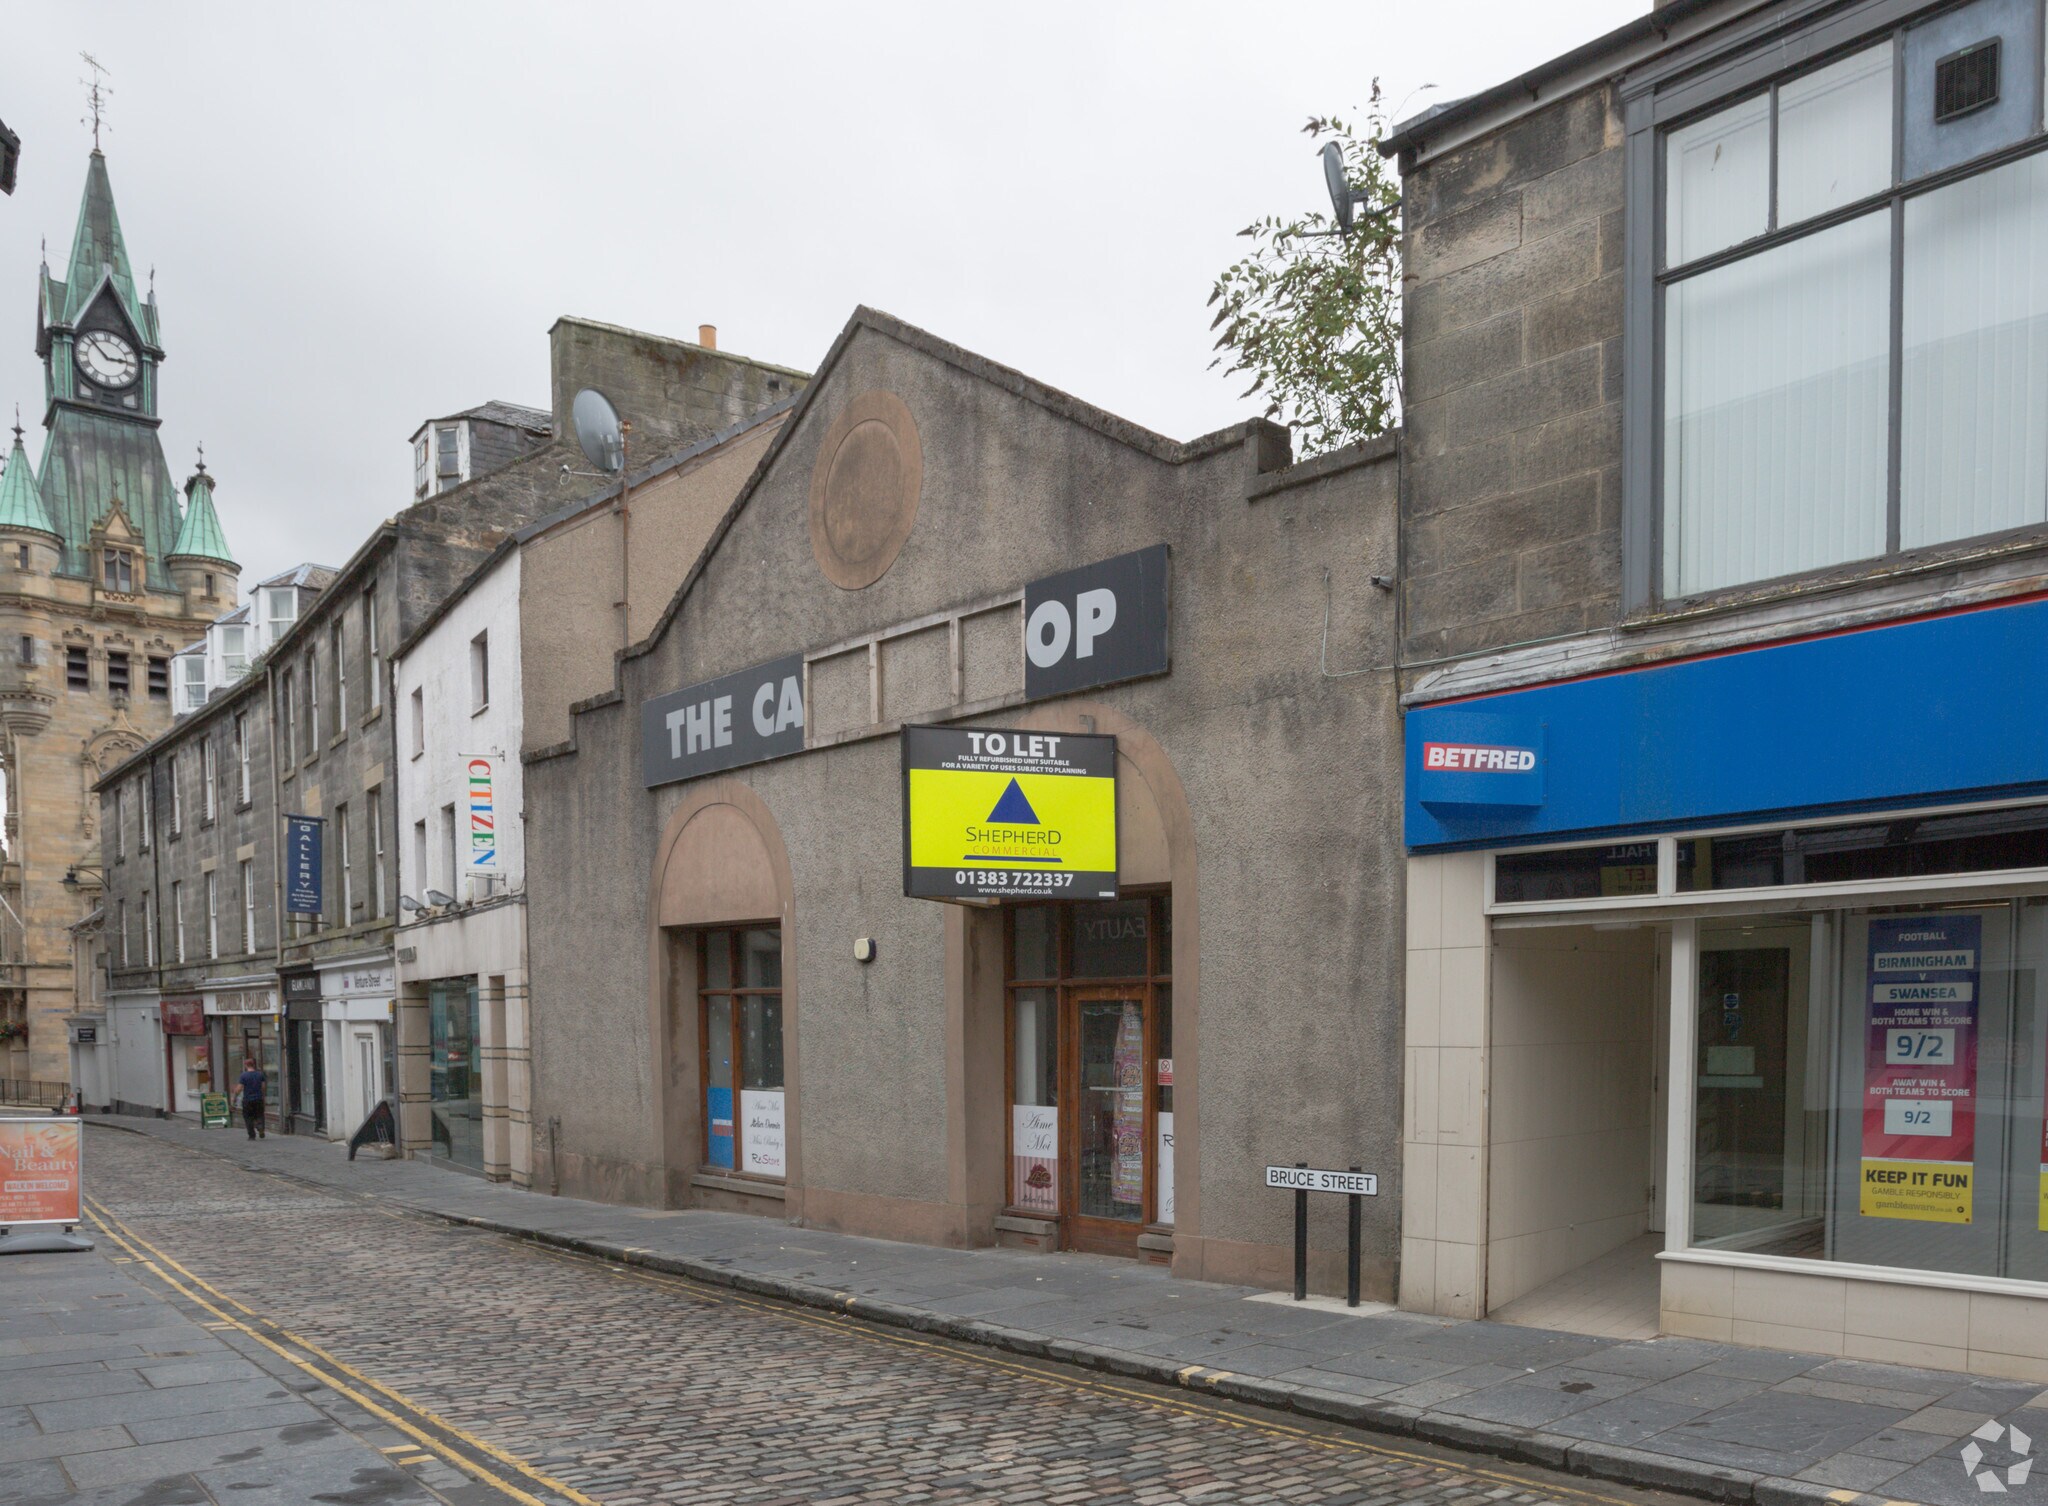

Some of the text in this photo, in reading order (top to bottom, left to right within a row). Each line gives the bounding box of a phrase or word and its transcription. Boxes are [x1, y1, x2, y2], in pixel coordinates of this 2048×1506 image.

[666, 588, 1117, 760] THE CA OP
[968, 732, 1061, 757] TO LET
[980, 756, 1022, 764] REFURBISHED
[1428, 747, 1536, 771] BETFRED
[1016, 765, 1044, 773] SUBJECT
[1054, 767, 1087, 775] PLANNING
[468, 759, 496, 867] CITIZEN
[966, 826, 1061, 845] SHEPHERD
[300, 825, 311, 889] GALLERY
[973, 845, 1057, 857] COMMERCIAL
[955, 870, 1074, 887] 01383 722337
[978, 886, 1052, 896] www.shepherd.co.uk
[1899, 931, 1946, 941] FOOTBALL
[1878, 955, 1967, 969] BIRMINGHAM
[1889, 987, 1957, 999] SWANSEA
[1894, 1008, 1949, 1017] HOME WIN &
[1871, 1017, 1972, 1026] BOTH TEAMS TO SCORE
[1897, 1035, 1944, 1058] 9/2
[1892, 1079, 1917, 1087] AWAY
[1919, 1079, 1937, 1087] WIN
[1870, 1087, 1970, 1097] BOTH TEAMS TO SCORE
[1022, 1111, 1053, 1130] Aime
[1904, 1111, 1931, 1124] 9/2
[1026, 1134, 1052, 1151] Moi
[41, 1144, 54, 1157] &
[15, 1158, 77, 1173] Beauty
[6, 1182, 25, 1190] WALK
[34, 1180, 67, 1190] WELCOME
[1270, 1170, 1372, 1191] BRUCE STREET
[1866, 1169, 1968, 1188] KEEP IT FUN
[1872, 1187, 1960, 1199] GAMBLE RESPONSIBLY
